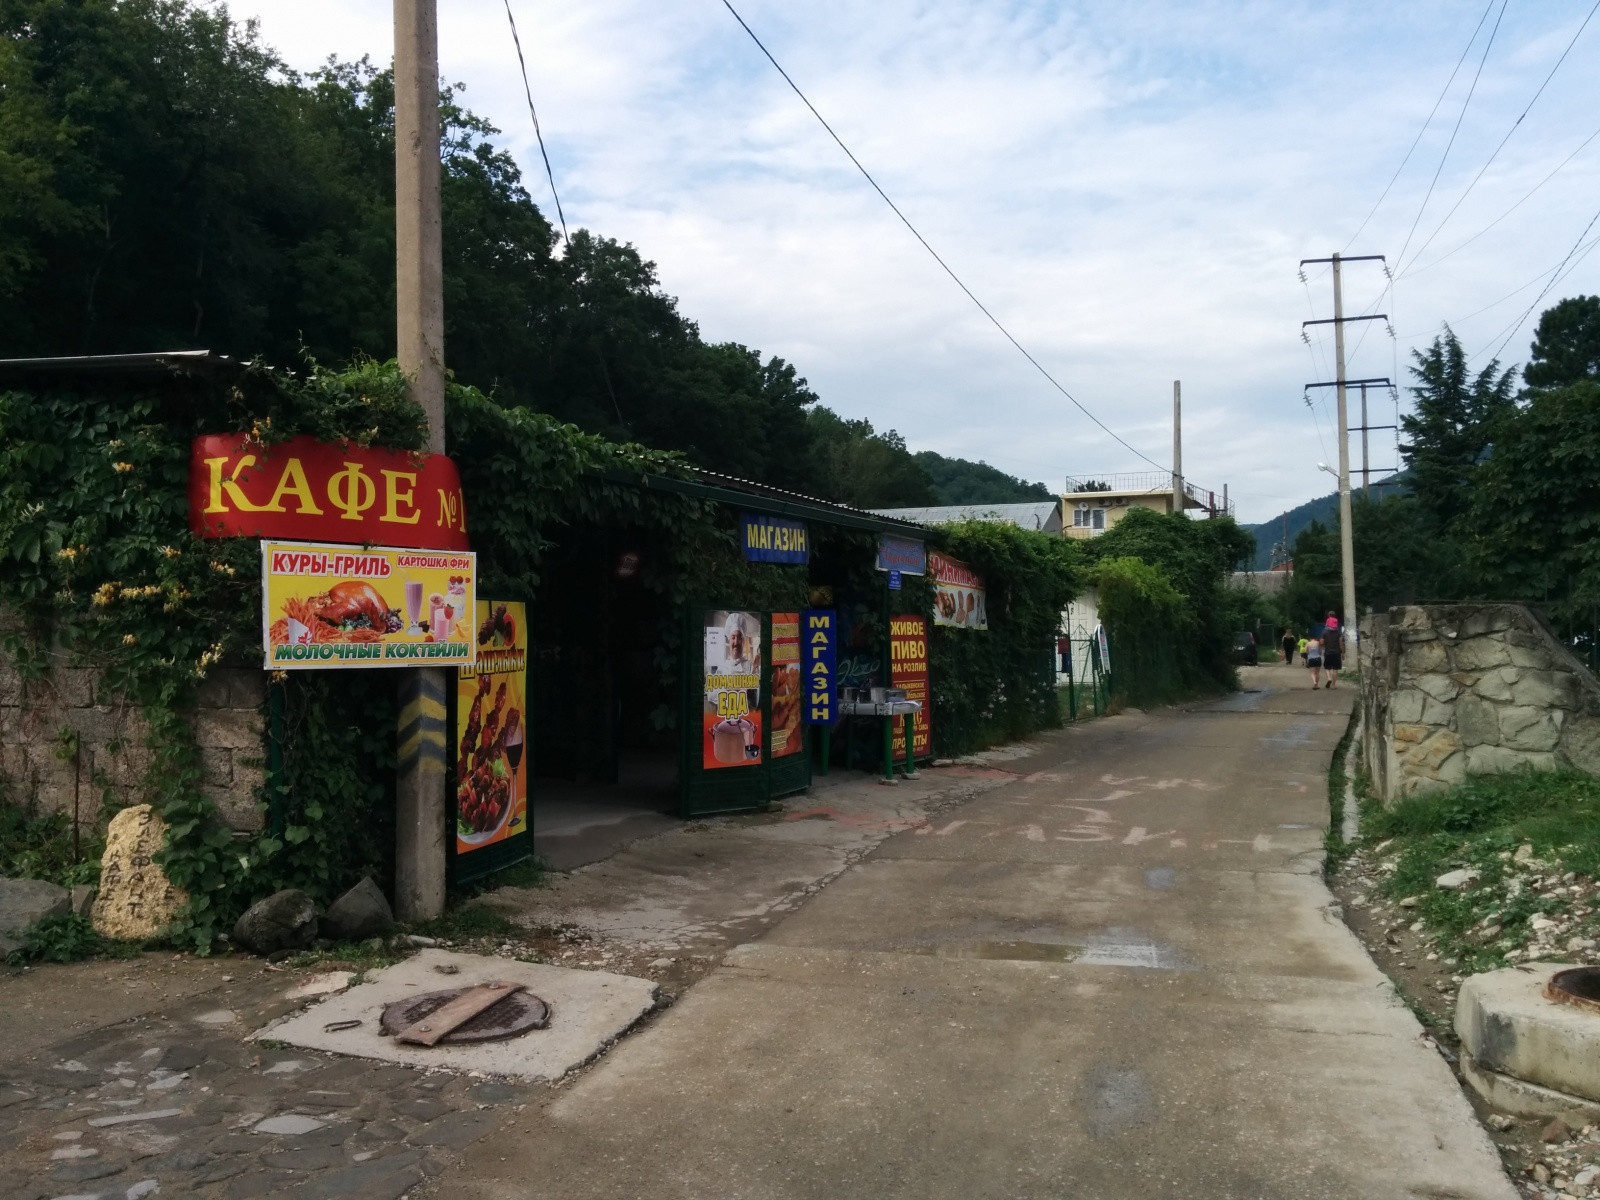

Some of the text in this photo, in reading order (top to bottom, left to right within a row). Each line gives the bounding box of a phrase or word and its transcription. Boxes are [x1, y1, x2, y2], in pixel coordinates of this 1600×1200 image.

[203, 455, 421, 525] КАФЕ
[746, 524, 806, 552] МАГАЗИН
[271, 552, 391, 578] КУРЫ-ГРИЛЬ
[396, 555, 470, 570] КАРТОШКА ФРИ
[890, 621, 924, 637] ЖИВОЕ
[274, 640, 470, 661] МОЛОЧНЫЕ КОКТЕЙЛИ
[890, 640, 926, 660] ПИВО
[808, 615, 831, 721] МАГАЗИН
[891, 662, 927, 674] НА РОЗЛИВ
[704, 674, 760, 692] ДОМАШНЯЯ
[717, 692, 750, 719] ЕДА
[891, 733, 928, 750] ПРОКТЫ
